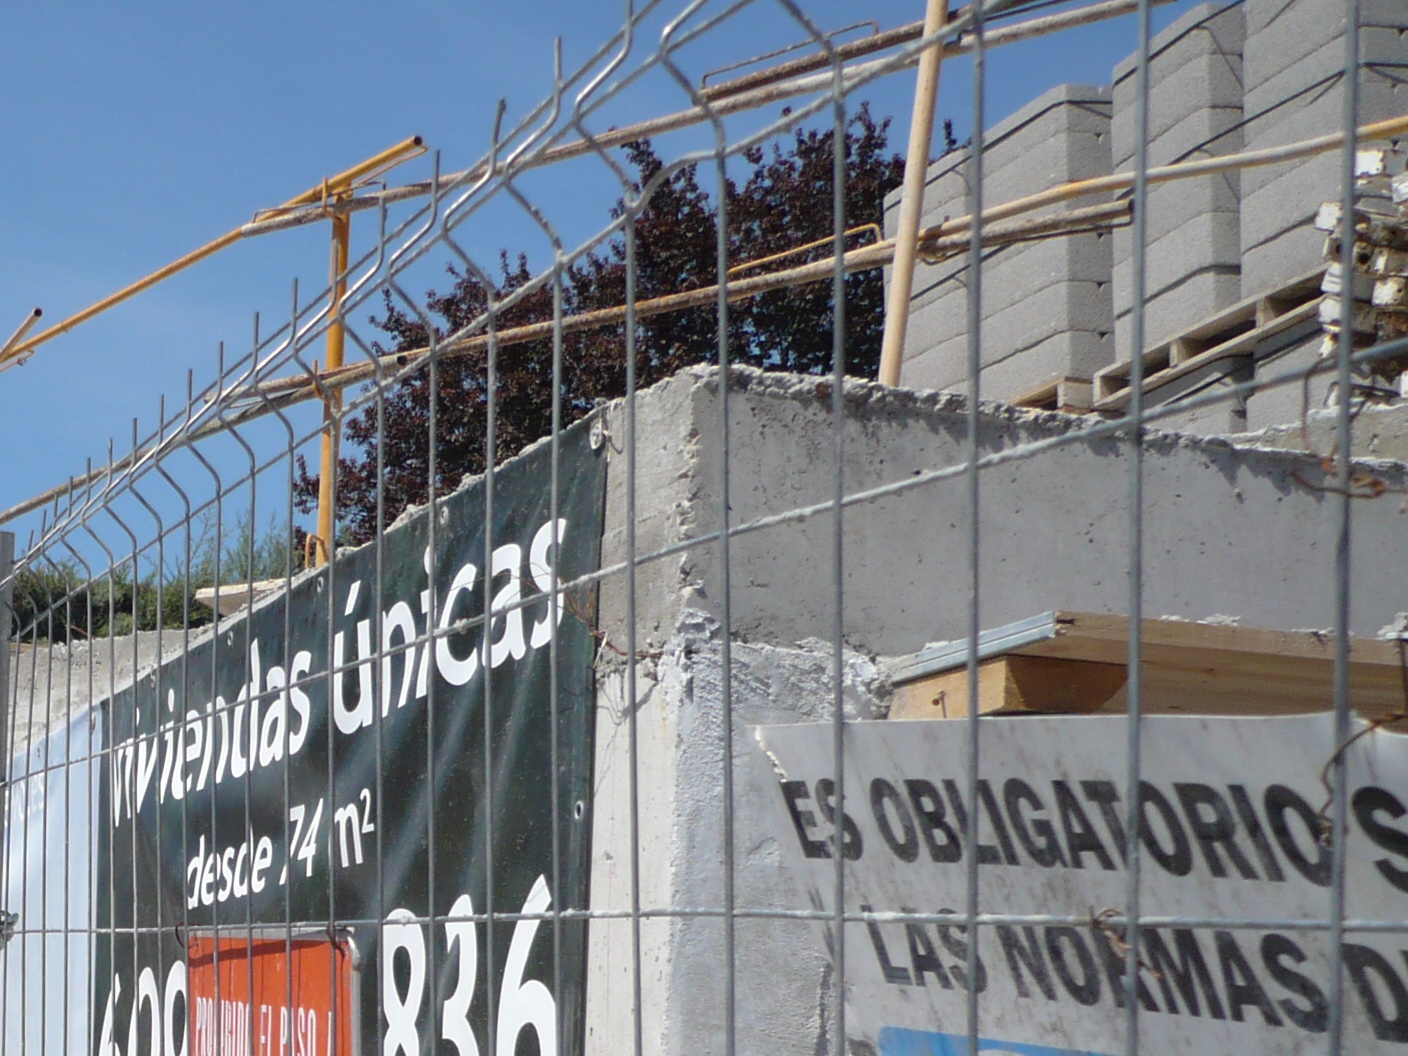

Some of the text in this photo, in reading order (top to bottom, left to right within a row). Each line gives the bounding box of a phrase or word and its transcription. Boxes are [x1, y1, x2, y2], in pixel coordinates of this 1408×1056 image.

[112, 518, 567, 828] viviendas únicas
[186, 834, 274, 911] desde
[279, 797, 324, 887] 74
[780, 778, 864, 861] ES
[870, 777, 1333, 888] OBLIGATORIO
[858, 904, 1408, 1044] LAS NORMAS D
